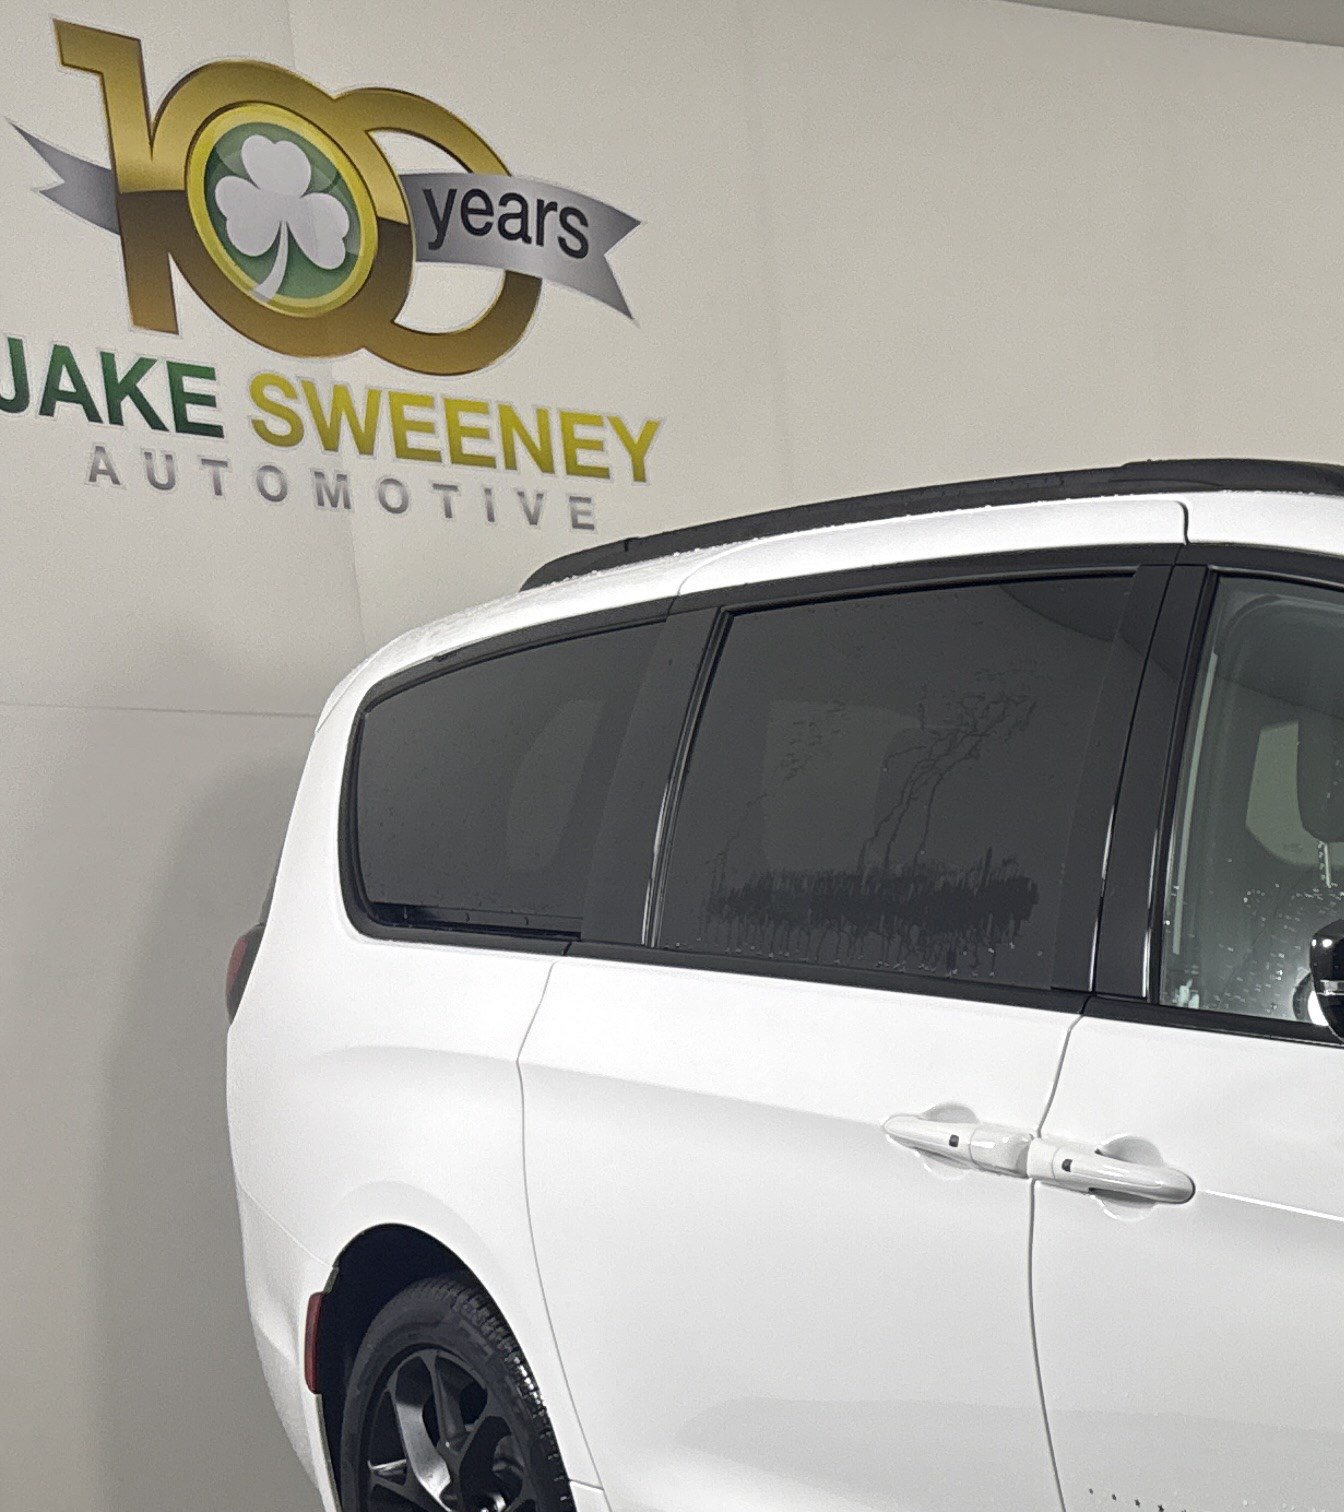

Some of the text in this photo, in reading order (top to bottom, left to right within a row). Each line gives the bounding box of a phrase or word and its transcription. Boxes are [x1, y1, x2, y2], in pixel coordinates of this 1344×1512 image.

[53, 18, 591, 377] 100 years
[0, 336, 662, 485] JAKE SWEENEY
[87, 445, 596, 532] AUTOMOTIVE
